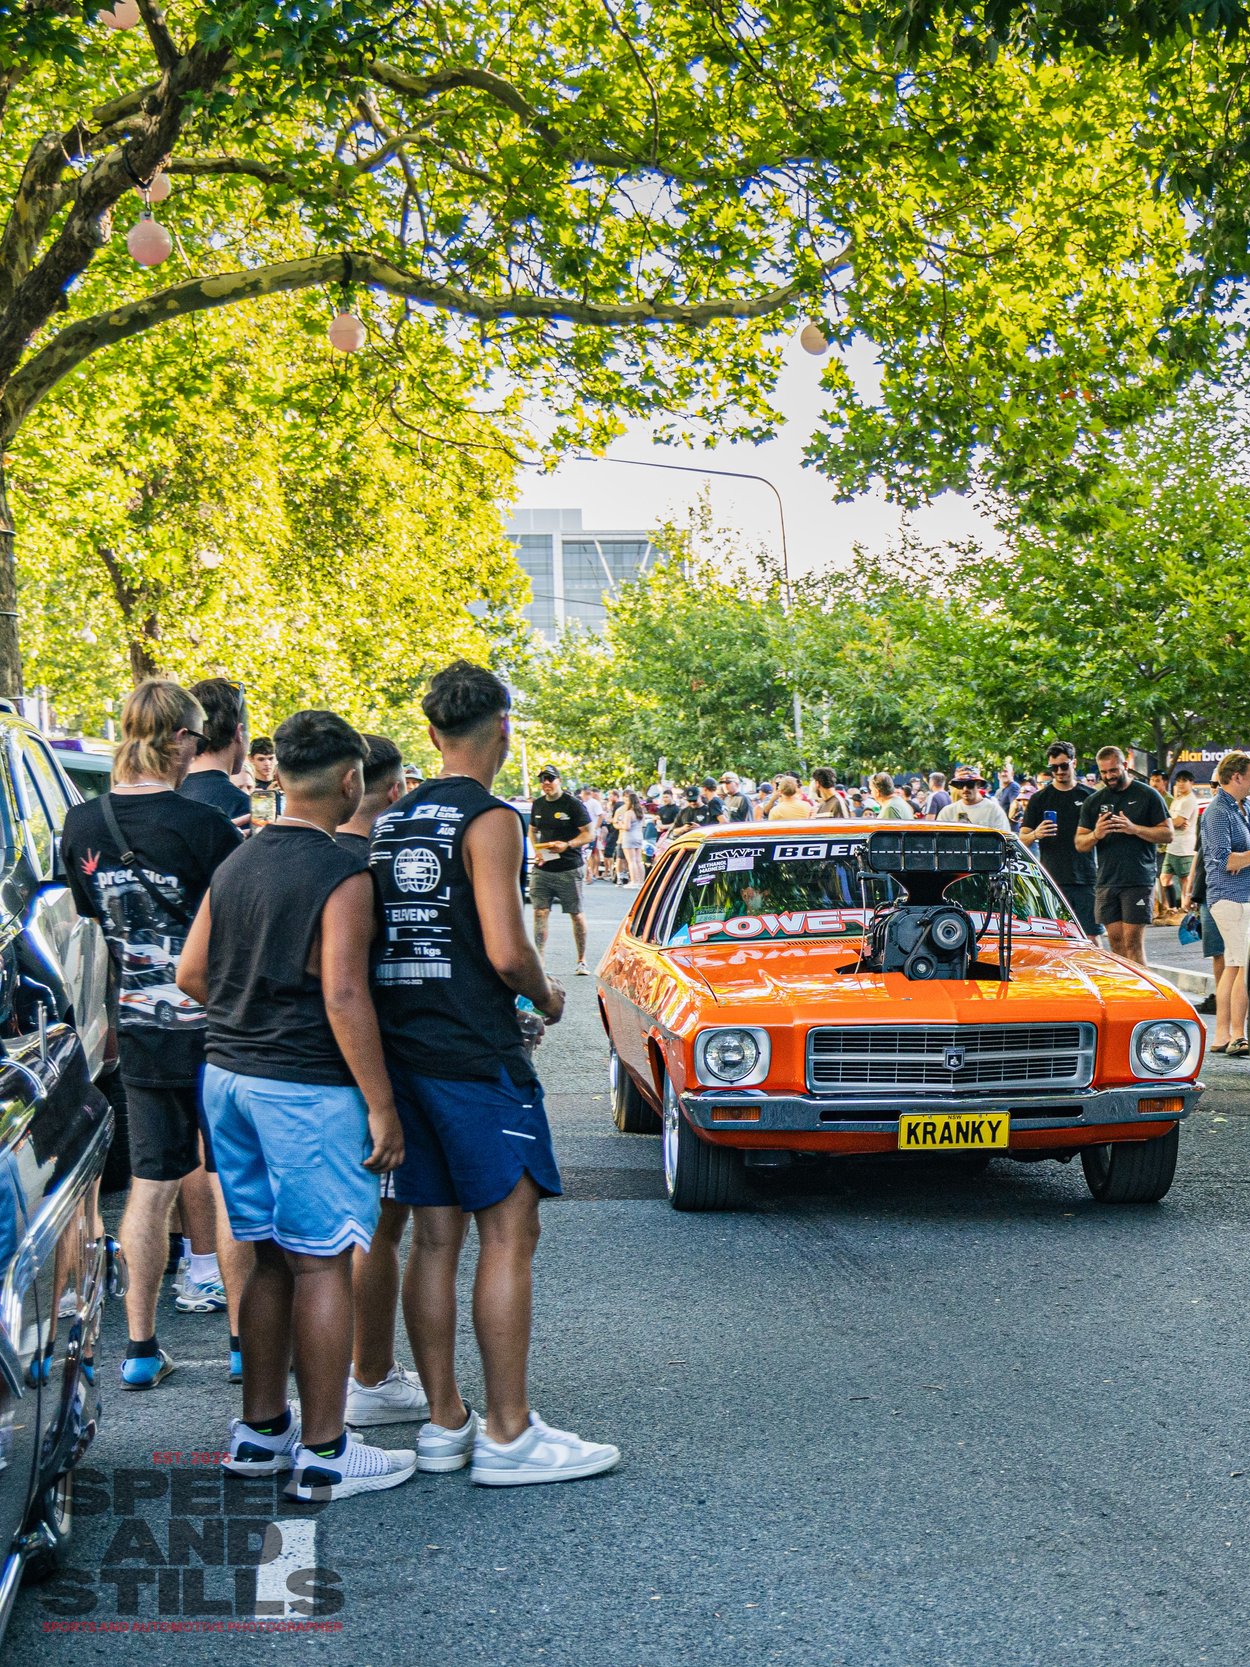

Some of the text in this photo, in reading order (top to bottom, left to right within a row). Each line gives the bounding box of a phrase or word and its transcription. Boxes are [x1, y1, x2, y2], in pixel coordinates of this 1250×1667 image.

[437, 827, 456, 836] AUS
[708, 848, 765, 861] KWT
[778, 845, 825, 858] BG
[699, 866, 726, 874] MADNESS
[423, 947, 442, 957] kgs
[906, 1120, 1002, 1145] KRANKY
